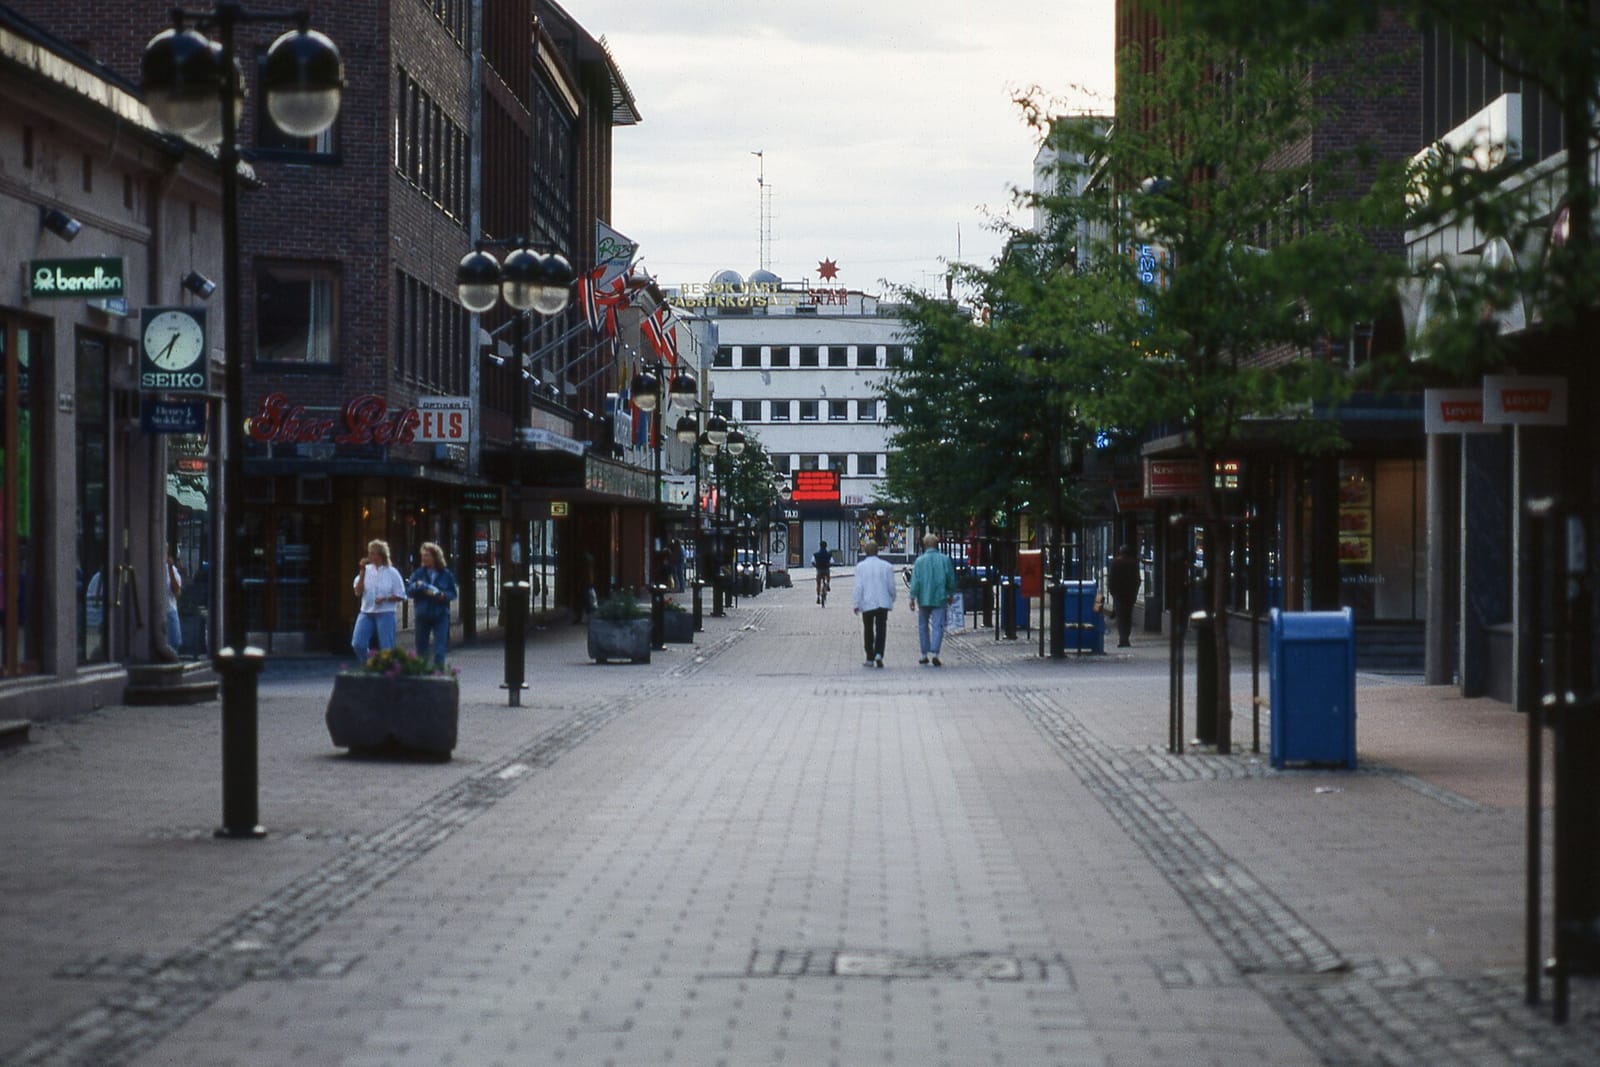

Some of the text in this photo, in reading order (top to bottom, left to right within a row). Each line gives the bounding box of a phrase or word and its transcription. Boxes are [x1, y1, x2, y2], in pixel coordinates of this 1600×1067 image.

[56, 266, 122, 291] benetton
[681, 282, 735, 294] BESØK
[808, 288, 848, 305] STAR
[142, 373, 204, 388] SEIKO
[784, 510, 799, 518] TAXI
